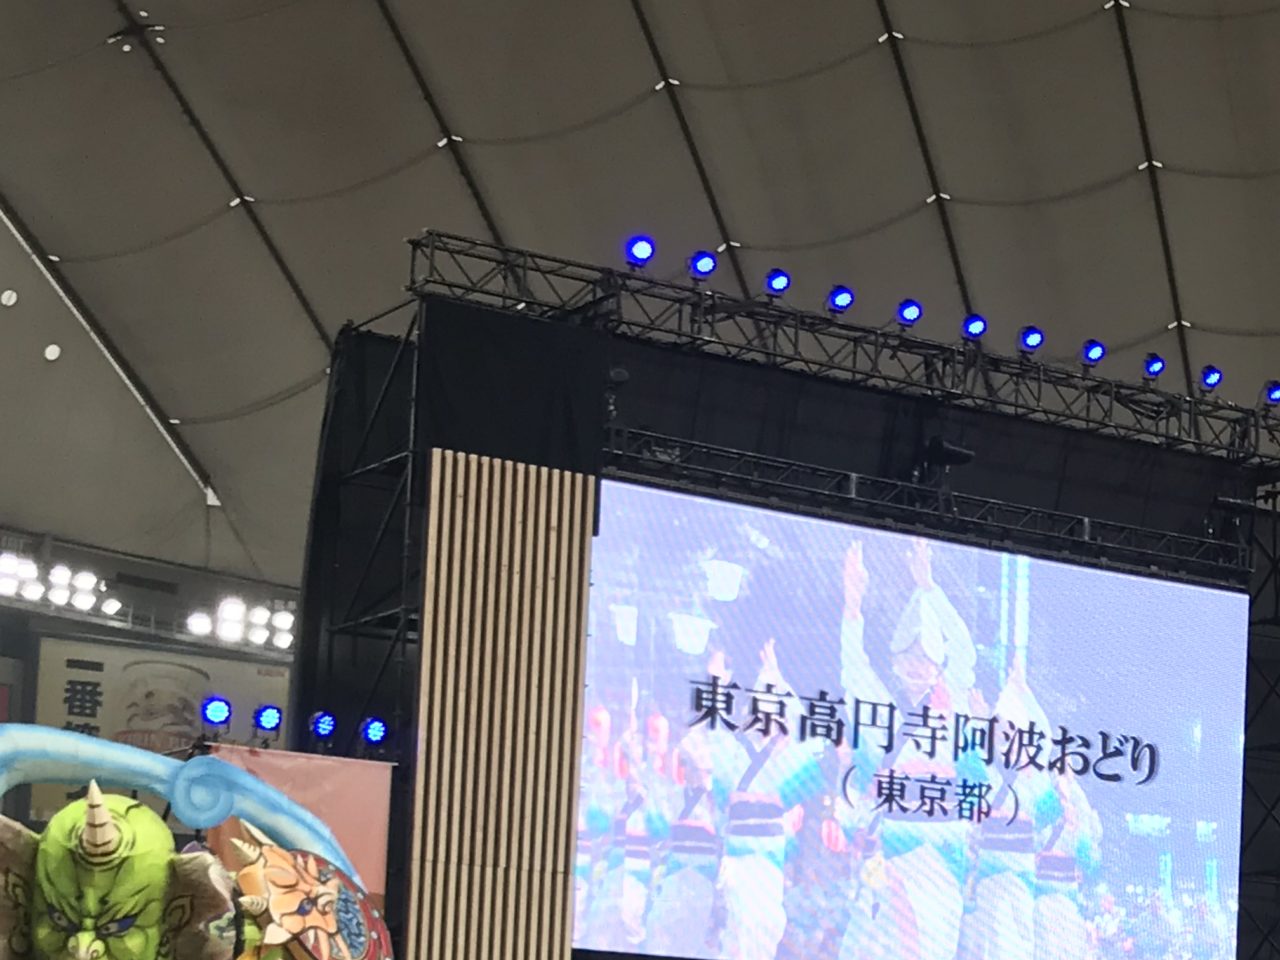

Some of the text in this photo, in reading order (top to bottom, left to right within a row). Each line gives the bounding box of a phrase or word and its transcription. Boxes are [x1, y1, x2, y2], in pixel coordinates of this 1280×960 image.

[688, 676, 1161, 786] 東京高円寺阿波おどり
